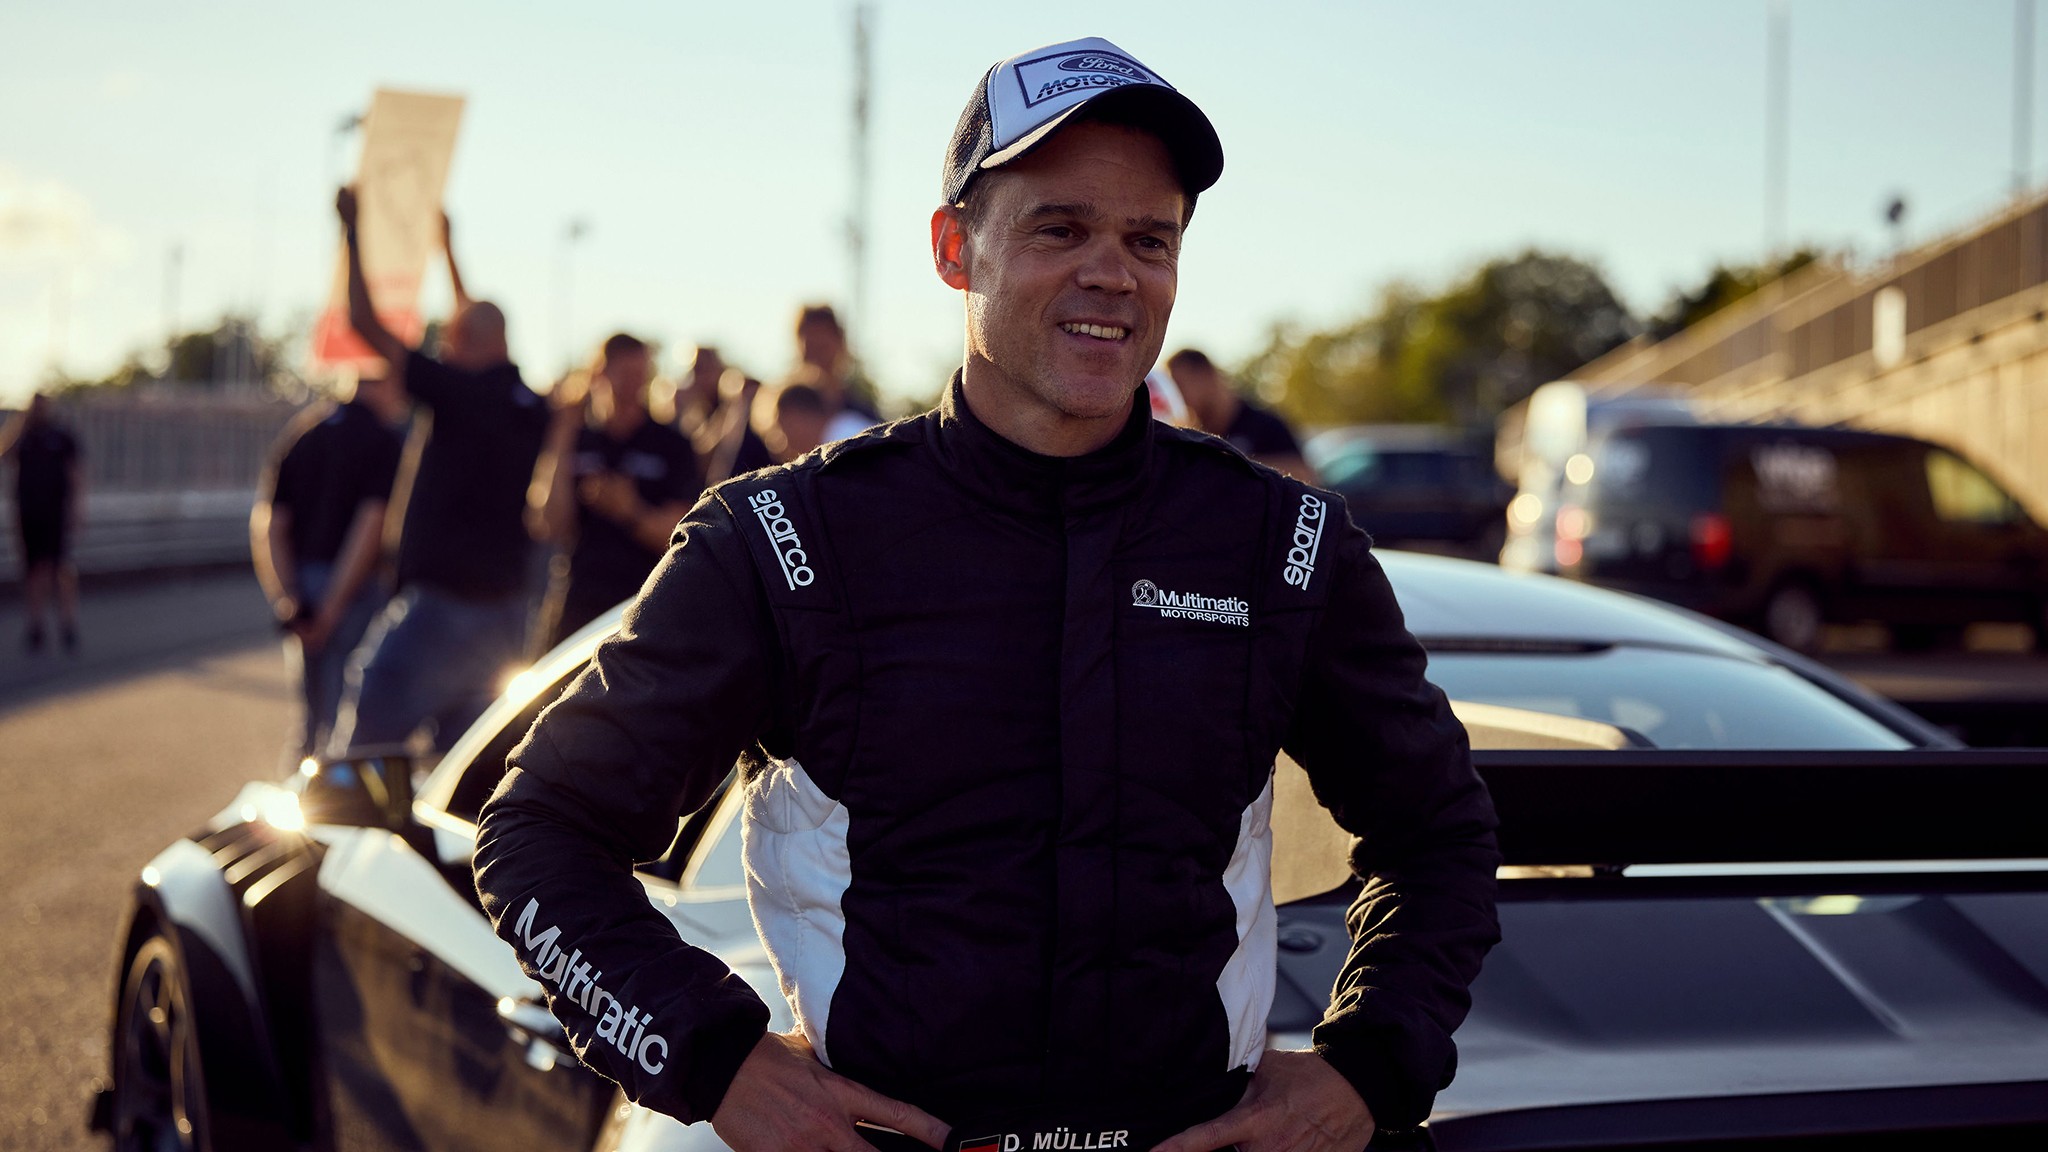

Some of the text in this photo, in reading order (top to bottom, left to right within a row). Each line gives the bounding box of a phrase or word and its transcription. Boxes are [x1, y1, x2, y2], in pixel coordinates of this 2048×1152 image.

[1078, 57, 1134, 76] Ford
[748, 489, 815, 591] sparco
[1283, 494, 1327, 591] sparco
[1159, 589, 1249, 613] Multimatic
[1160, 609, 1250, 627] MOTORSPORTS
[1032, 1127, 1129, 1150] MÜLLER
